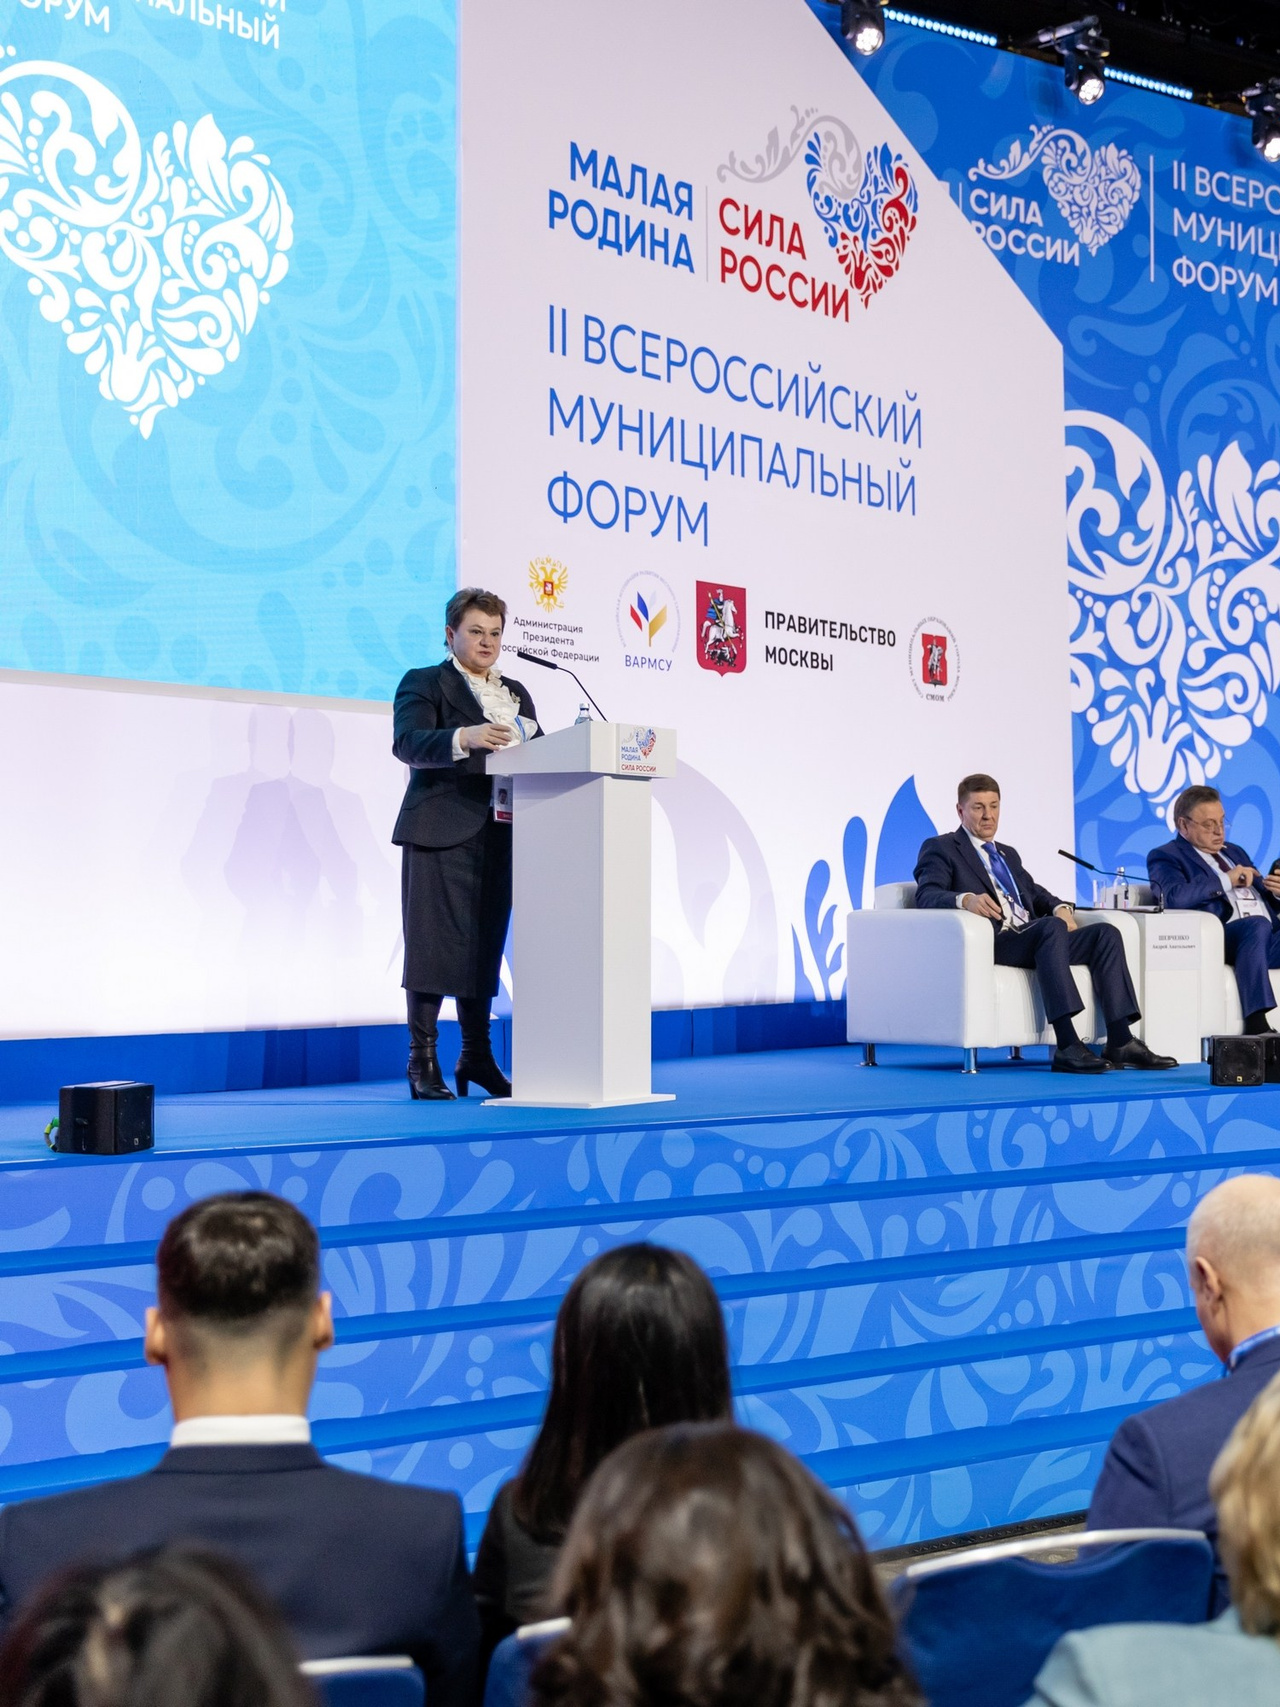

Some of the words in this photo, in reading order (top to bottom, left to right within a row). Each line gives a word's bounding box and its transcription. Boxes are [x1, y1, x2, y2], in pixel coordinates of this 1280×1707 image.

[569, 140, 694, 222] МАЛАЯ
[1172, 160, 1186, 191] II
[969, 188, 1044, 228] СИЛА
[547, 188, 695, 274] РОДИНА
[718, 197, 807, 261] СИЛА
[719, 246, 850, 323] РОССИИ
[1172, 256, 1278, 306] ФОРУМ
[548, 304, 567, 357] II
[584, 313, 922, 449] ВСЕРОССИЙСКИЙ
[548, 387, 916, 516] МУНИЦИПАЛЬНЫЙ
[547, 470, 709, 547] ФОРУМ
[514, 616, 583, 634] Администрация
[522, 631, 575, 647] Президента
[764, 610, 897, 648] ПРАВИТЕЛЬСТВО
[501, 643, 549, 657] оссийской
[550, 648, 600, 663] Федерации
[624, 655, 673, 672] ВАРМСУ
[764, 646, 834, 672] МОСКВЫ
[621, 753, 641, 761] РОДИНА
[636, 764, 657, 772] РОССИИ
